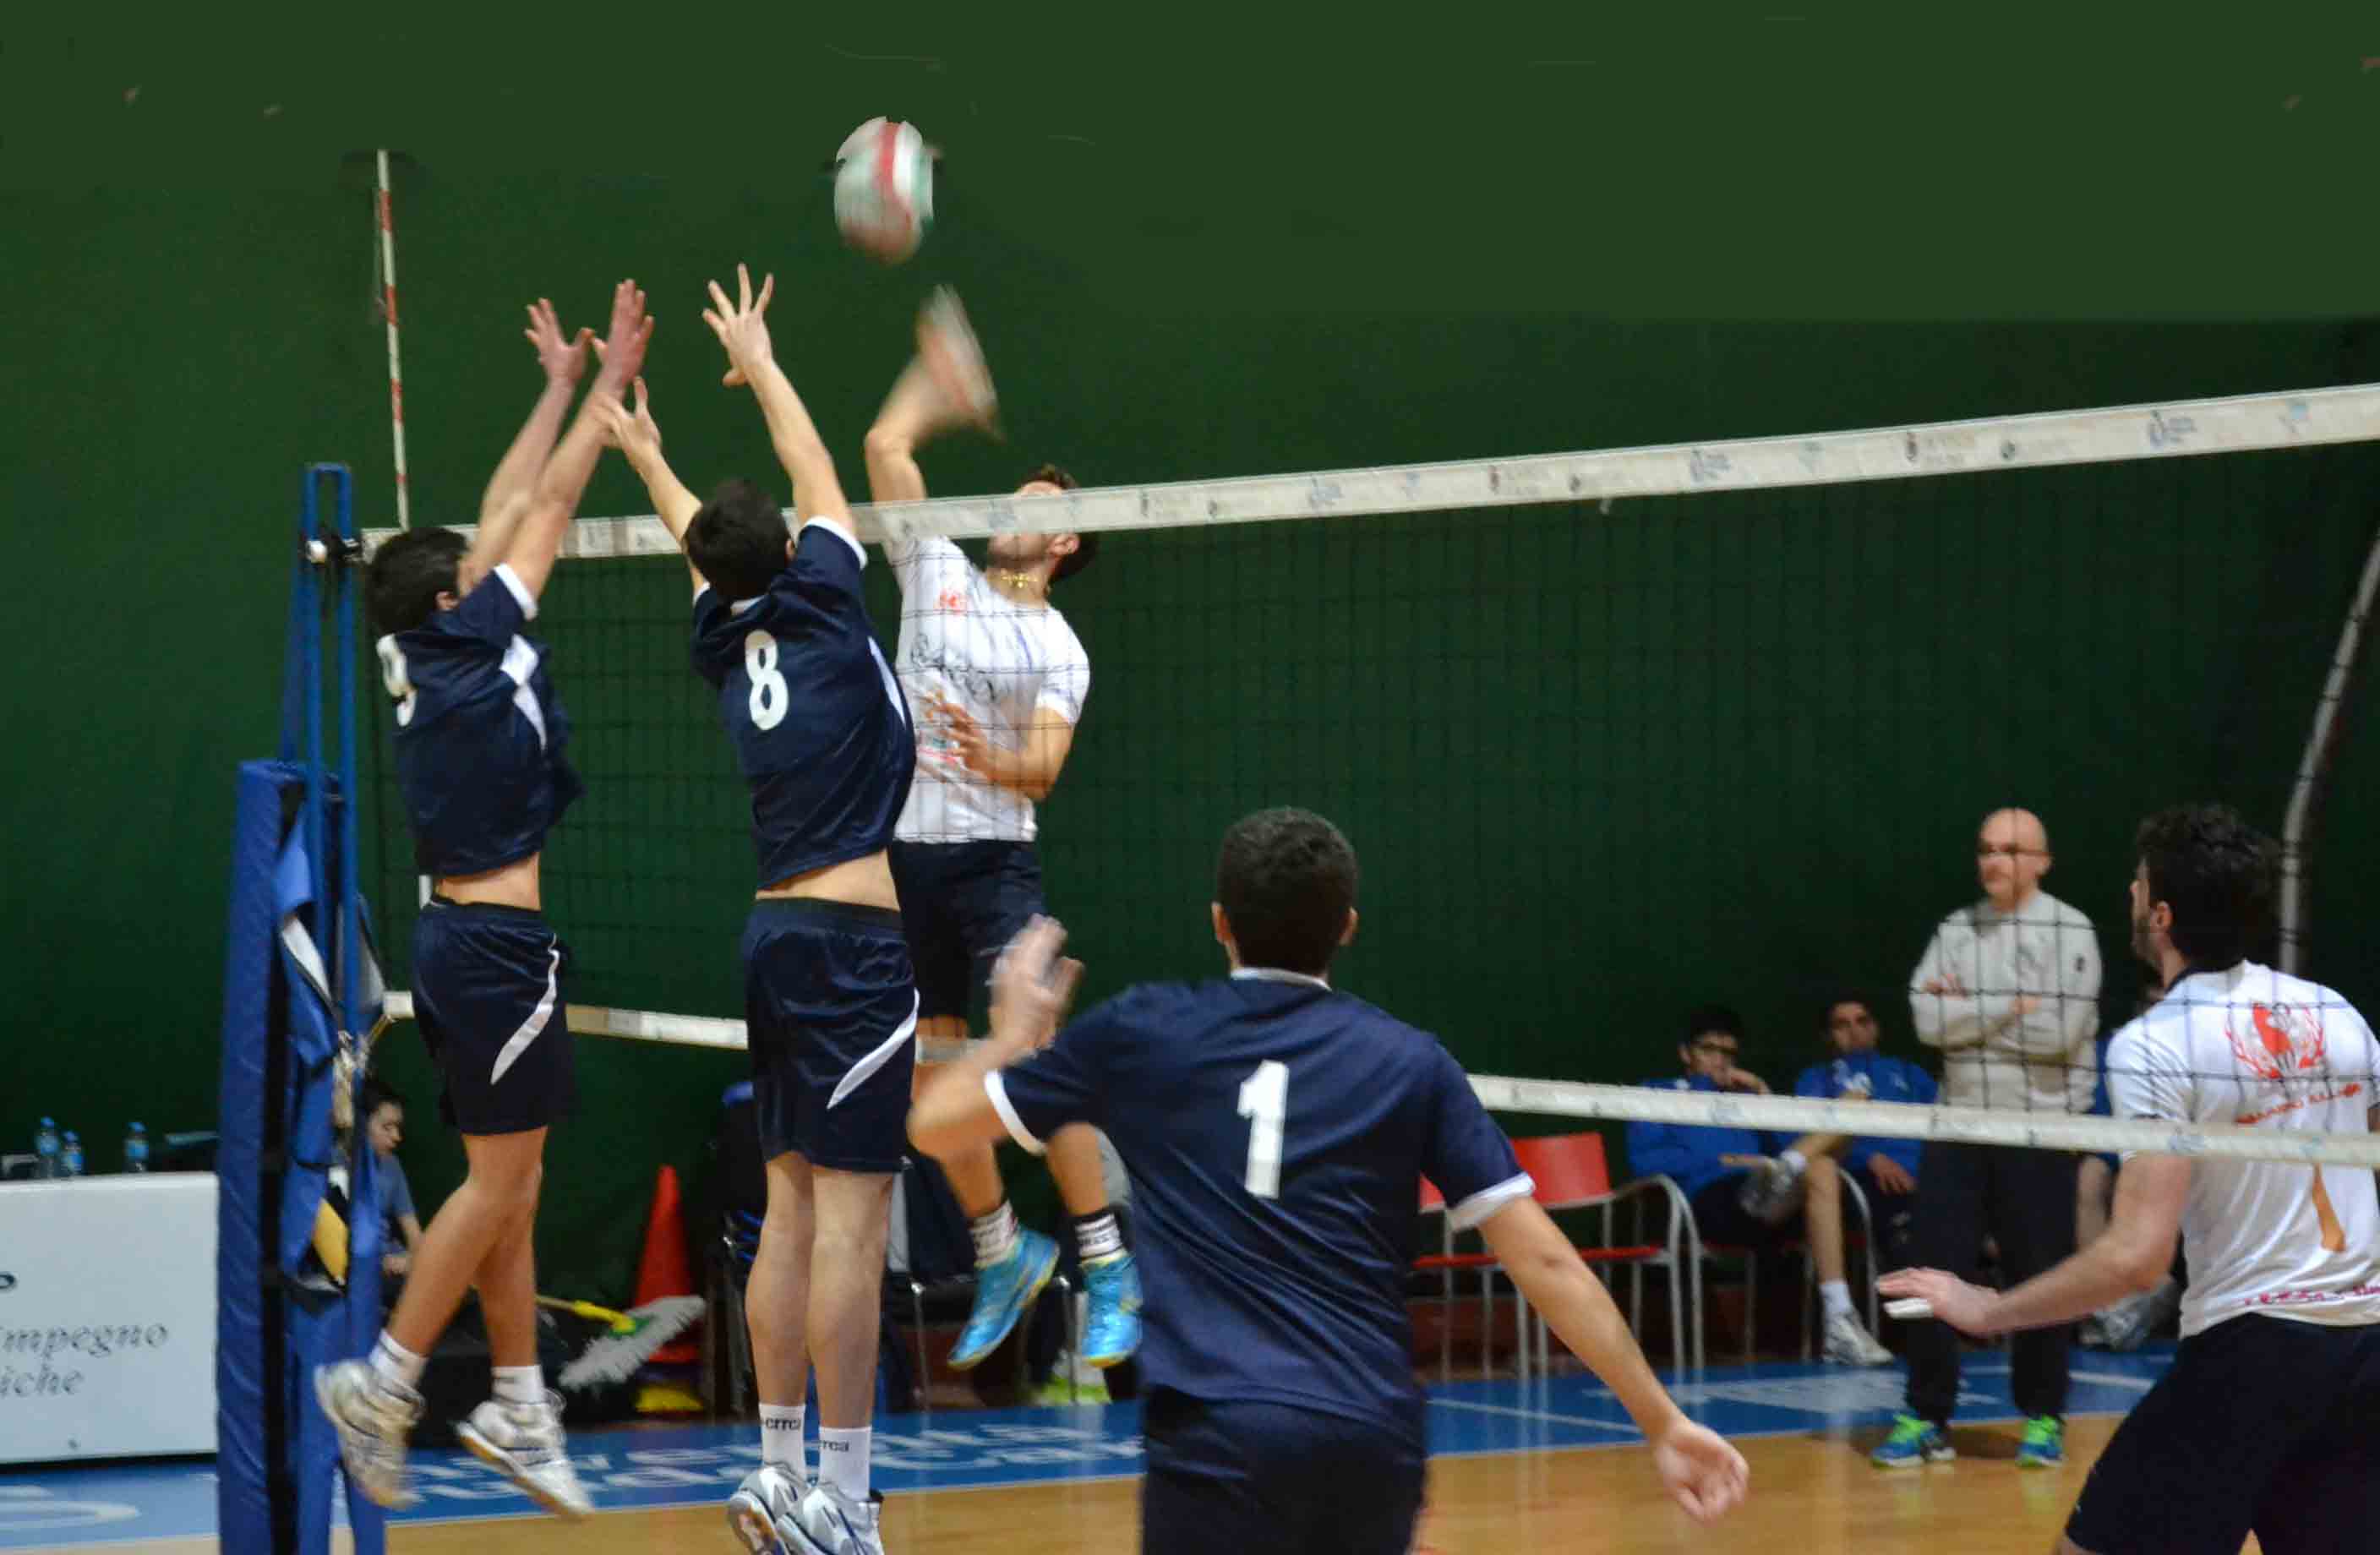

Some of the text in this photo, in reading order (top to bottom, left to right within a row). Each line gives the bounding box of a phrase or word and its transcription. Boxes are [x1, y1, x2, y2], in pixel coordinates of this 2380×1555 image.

[745, 629, 789, 730] 8
[1237, 1059, 1290, 1199] 1
[0, 1323, 169, 1358] mpegno
